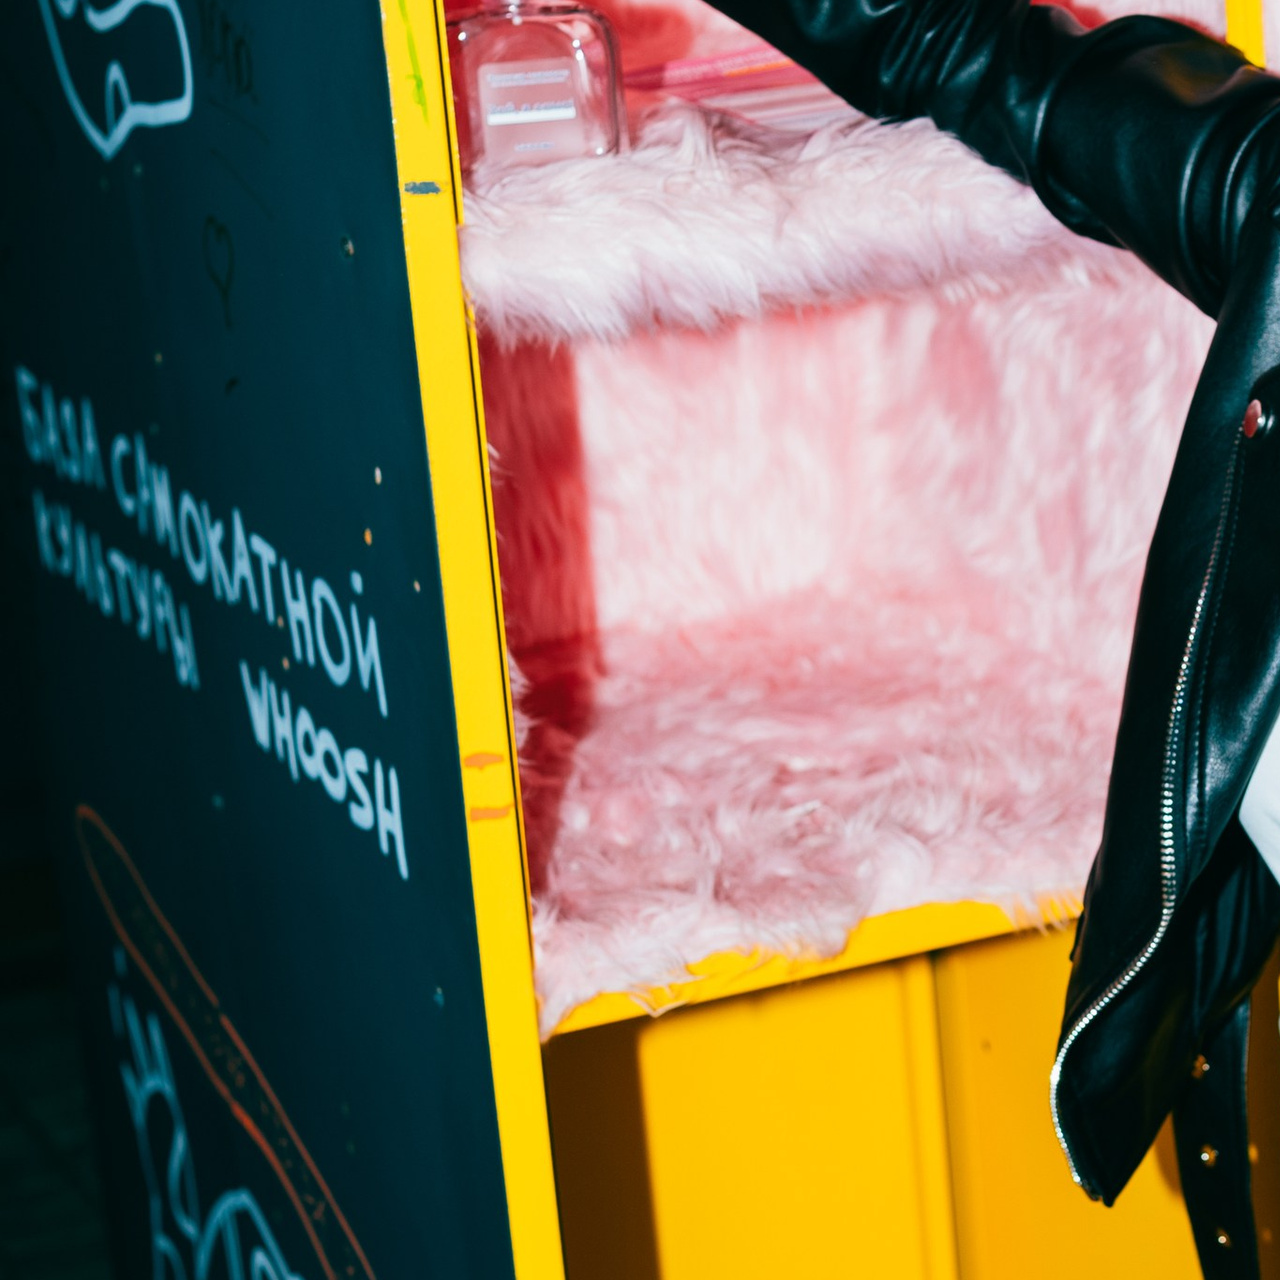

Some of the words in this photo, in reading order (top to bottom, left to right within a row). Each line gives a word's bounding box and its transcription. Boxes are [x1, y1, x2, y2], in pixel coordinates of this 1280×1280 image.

[15, 363, 105, 490] БАЗА
[111, 433, 389, 718] САМОКАТНОЙ
[33, 489, 199, 690] КУЛЬТУРЫ
[239, 658, 409, 880] WHOOSH
